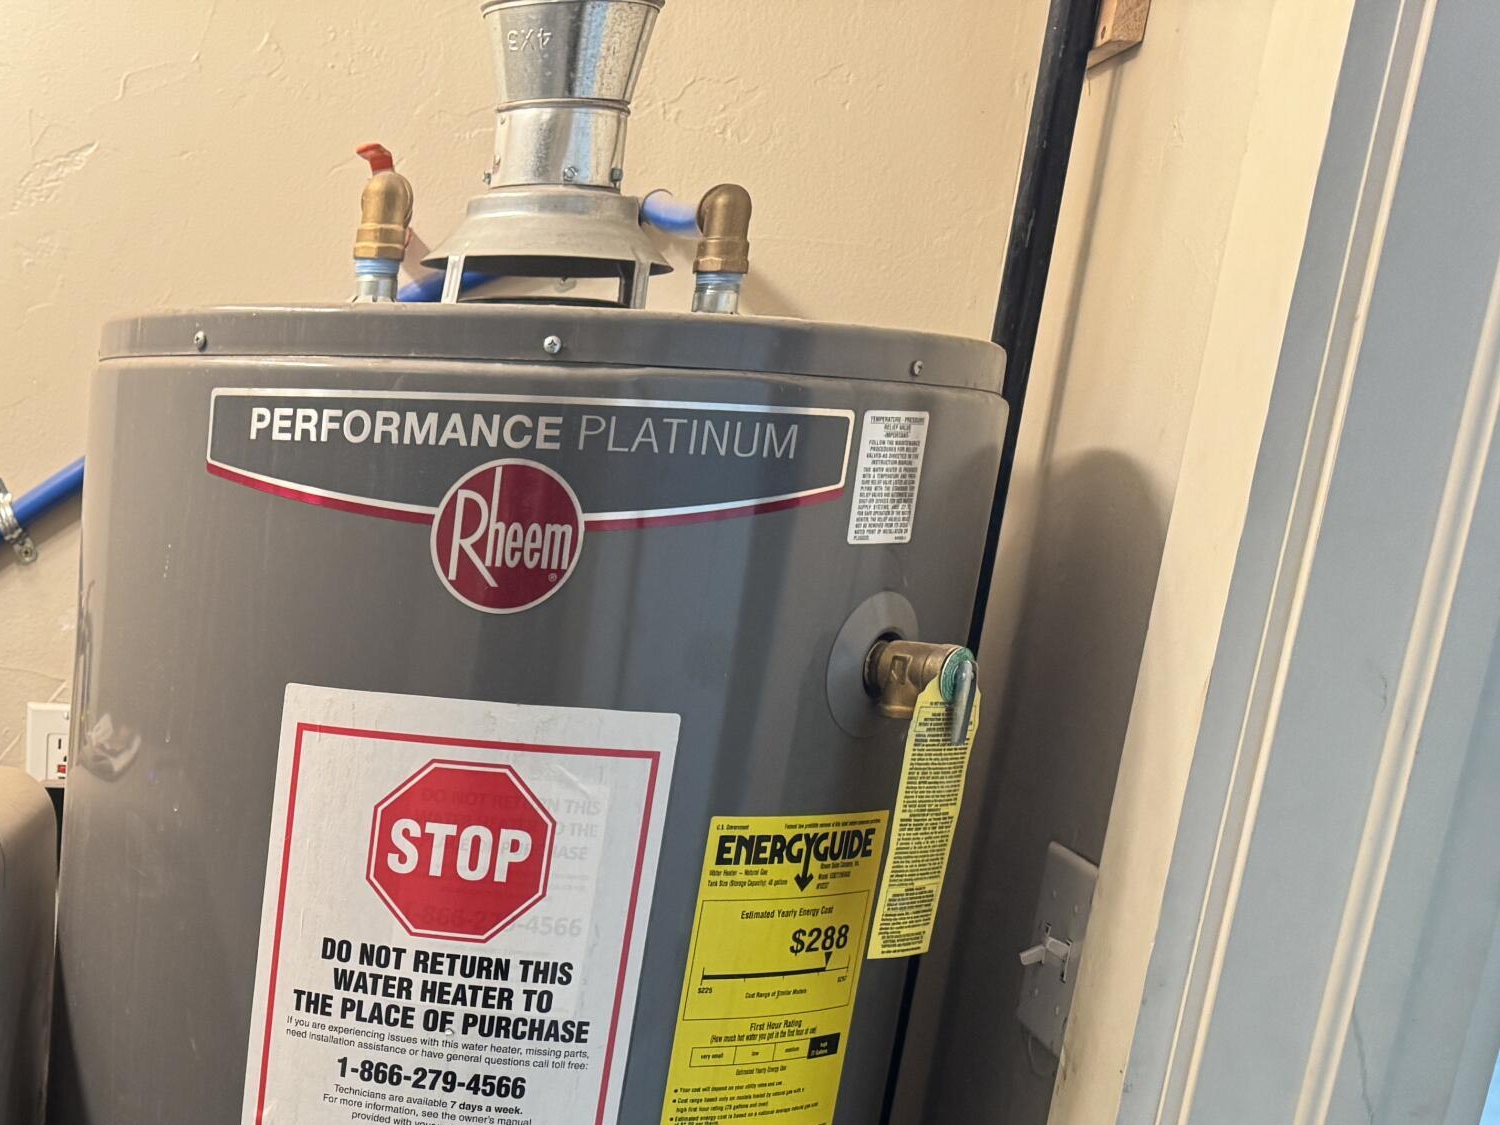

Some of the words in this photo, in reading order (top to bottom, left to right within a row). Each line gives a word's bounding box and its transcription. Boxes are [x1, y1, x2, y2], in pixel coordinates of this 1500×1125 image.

[507, 28, 552, 51] 4X3
[250, 407, 563, 450] PERFORMANCE
[578, 415, 798, 459] PLATINUM
[448, 466, 572, 587] Rheem
[387, 818, 532, 882] STOP
[715, 828, 876, 866] ENERGYGUIDE
[740, 909, 775, 919] Estimated
[777, 908, 797, 918] Yearly
[798, 907, 819, 916] Energy
[820, 906, 833, 914] Cost
[790, 924, 850, 956] $288
[321, 937, 351, 962] DO
[359, 943, 406, 969] NOT
[413, 950, 509, 980] RETURN
[519, 959, 572, 985] THIS
[334, 968, 412, 999] WATER
[420, 980, 513, 1009] HEATER
[522, 989, 552, 1013] TO
[294, 989, 333, 1016] THE
[340, 997, 414, 1028] PLACE
[422, 1008, 454, 1033] OF
[462, 1013, 588, 1043] PURCHASE
[749, 1022, 765, 1031] First
[766, 1021, 782, 1030] Hour
[782, 1019, 802, 1028] Rating
[286, 1015, 292, 1023] If
[294, 1018, 309, 1027] you
[311, 1021, 325, 1030] are
[327, 1024, 385, 1041] experiencing
[387, 1032, 417, 1044] issues
[419, 1037, 439, 1046] with
[441, 1039, 458, 1048] this
[461, 1043, 488, 1051] water
[489, 1043, 522, 1055] heater,
[525, 1048, 561, 1058] missing
[563, 1050, 588, 1058] parts,
[286, 1028, 307, 1038] need
[308, 1031, 355, 1046] installation
[357, 1041, 406, 1054] assistance
[420, 1048, 443, 1059] have
[446, 1053, 482, 1062] general
[484, 1056, 530, 1066] questions
[532, 1059, 549, 1067] call
[551, 1060, 565, 1068] toll
[567, 1060, 587, 1069] free:
[339, 1058, 524, 1098] 1-866-279-4566
[322, 1093, 338, 1103] For
[339, 1098, 362, 1107] more
[364, 1100, 418, 1116] information,
[421, 1110, 438, 1118] see
[441, 1111, 456, 1120] the
[458, 1114, 494, 1124] owner's
[497, 1118, 531, 1125] manual
[334, 1083, 386, 1100] Technicians
[388, 1094, 404, 1102] are
[406, 1096, 447, 1107] available
[450, 1100, 457, 1108] 7
[458, 1101, 482, 1112] days
[494, 1106, 522, 1114] week.
[351, 1111, 390, 1123] provided
[393, 1118, 411, 1125] with
